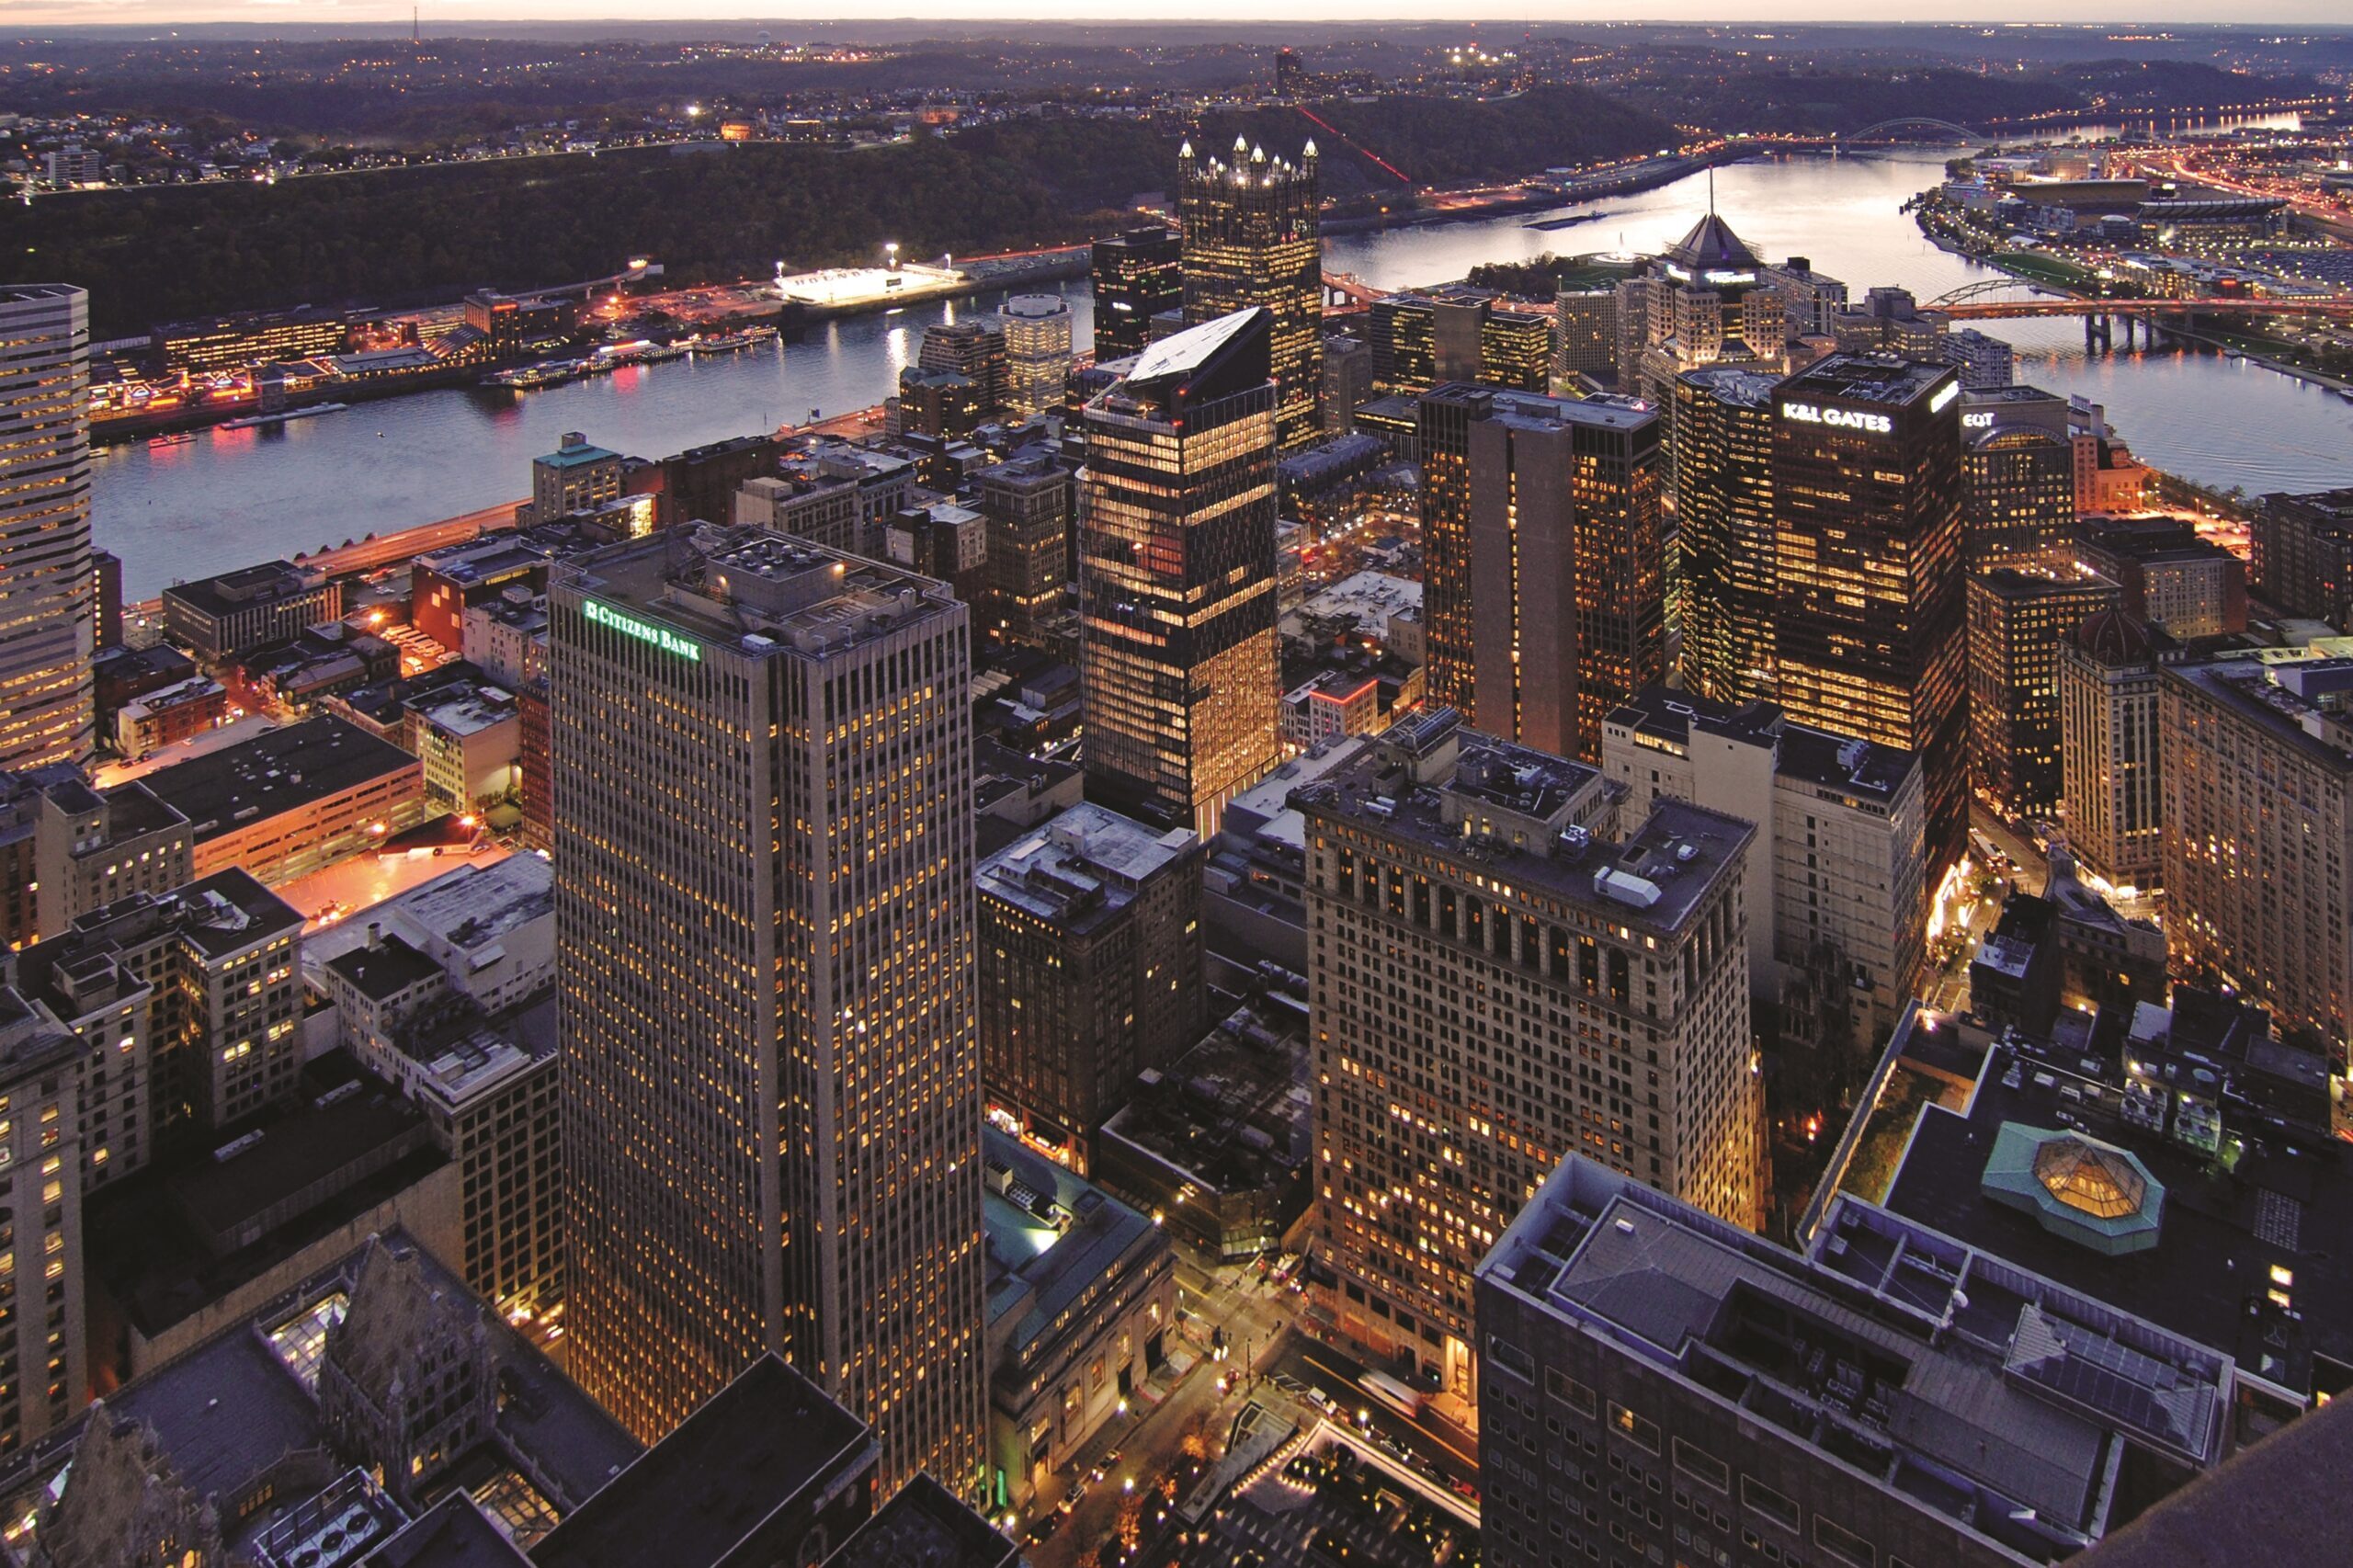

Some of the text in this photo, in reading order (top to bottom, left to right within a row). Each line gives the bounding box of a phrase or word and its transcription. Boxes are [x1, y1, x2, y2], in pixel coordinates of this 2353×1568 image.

[1783, 403, 1892, 433] K&L GATES
[1962, 413, 1995, 426] EQT
[598, 607, 699, 660] CITIZENS BANK
